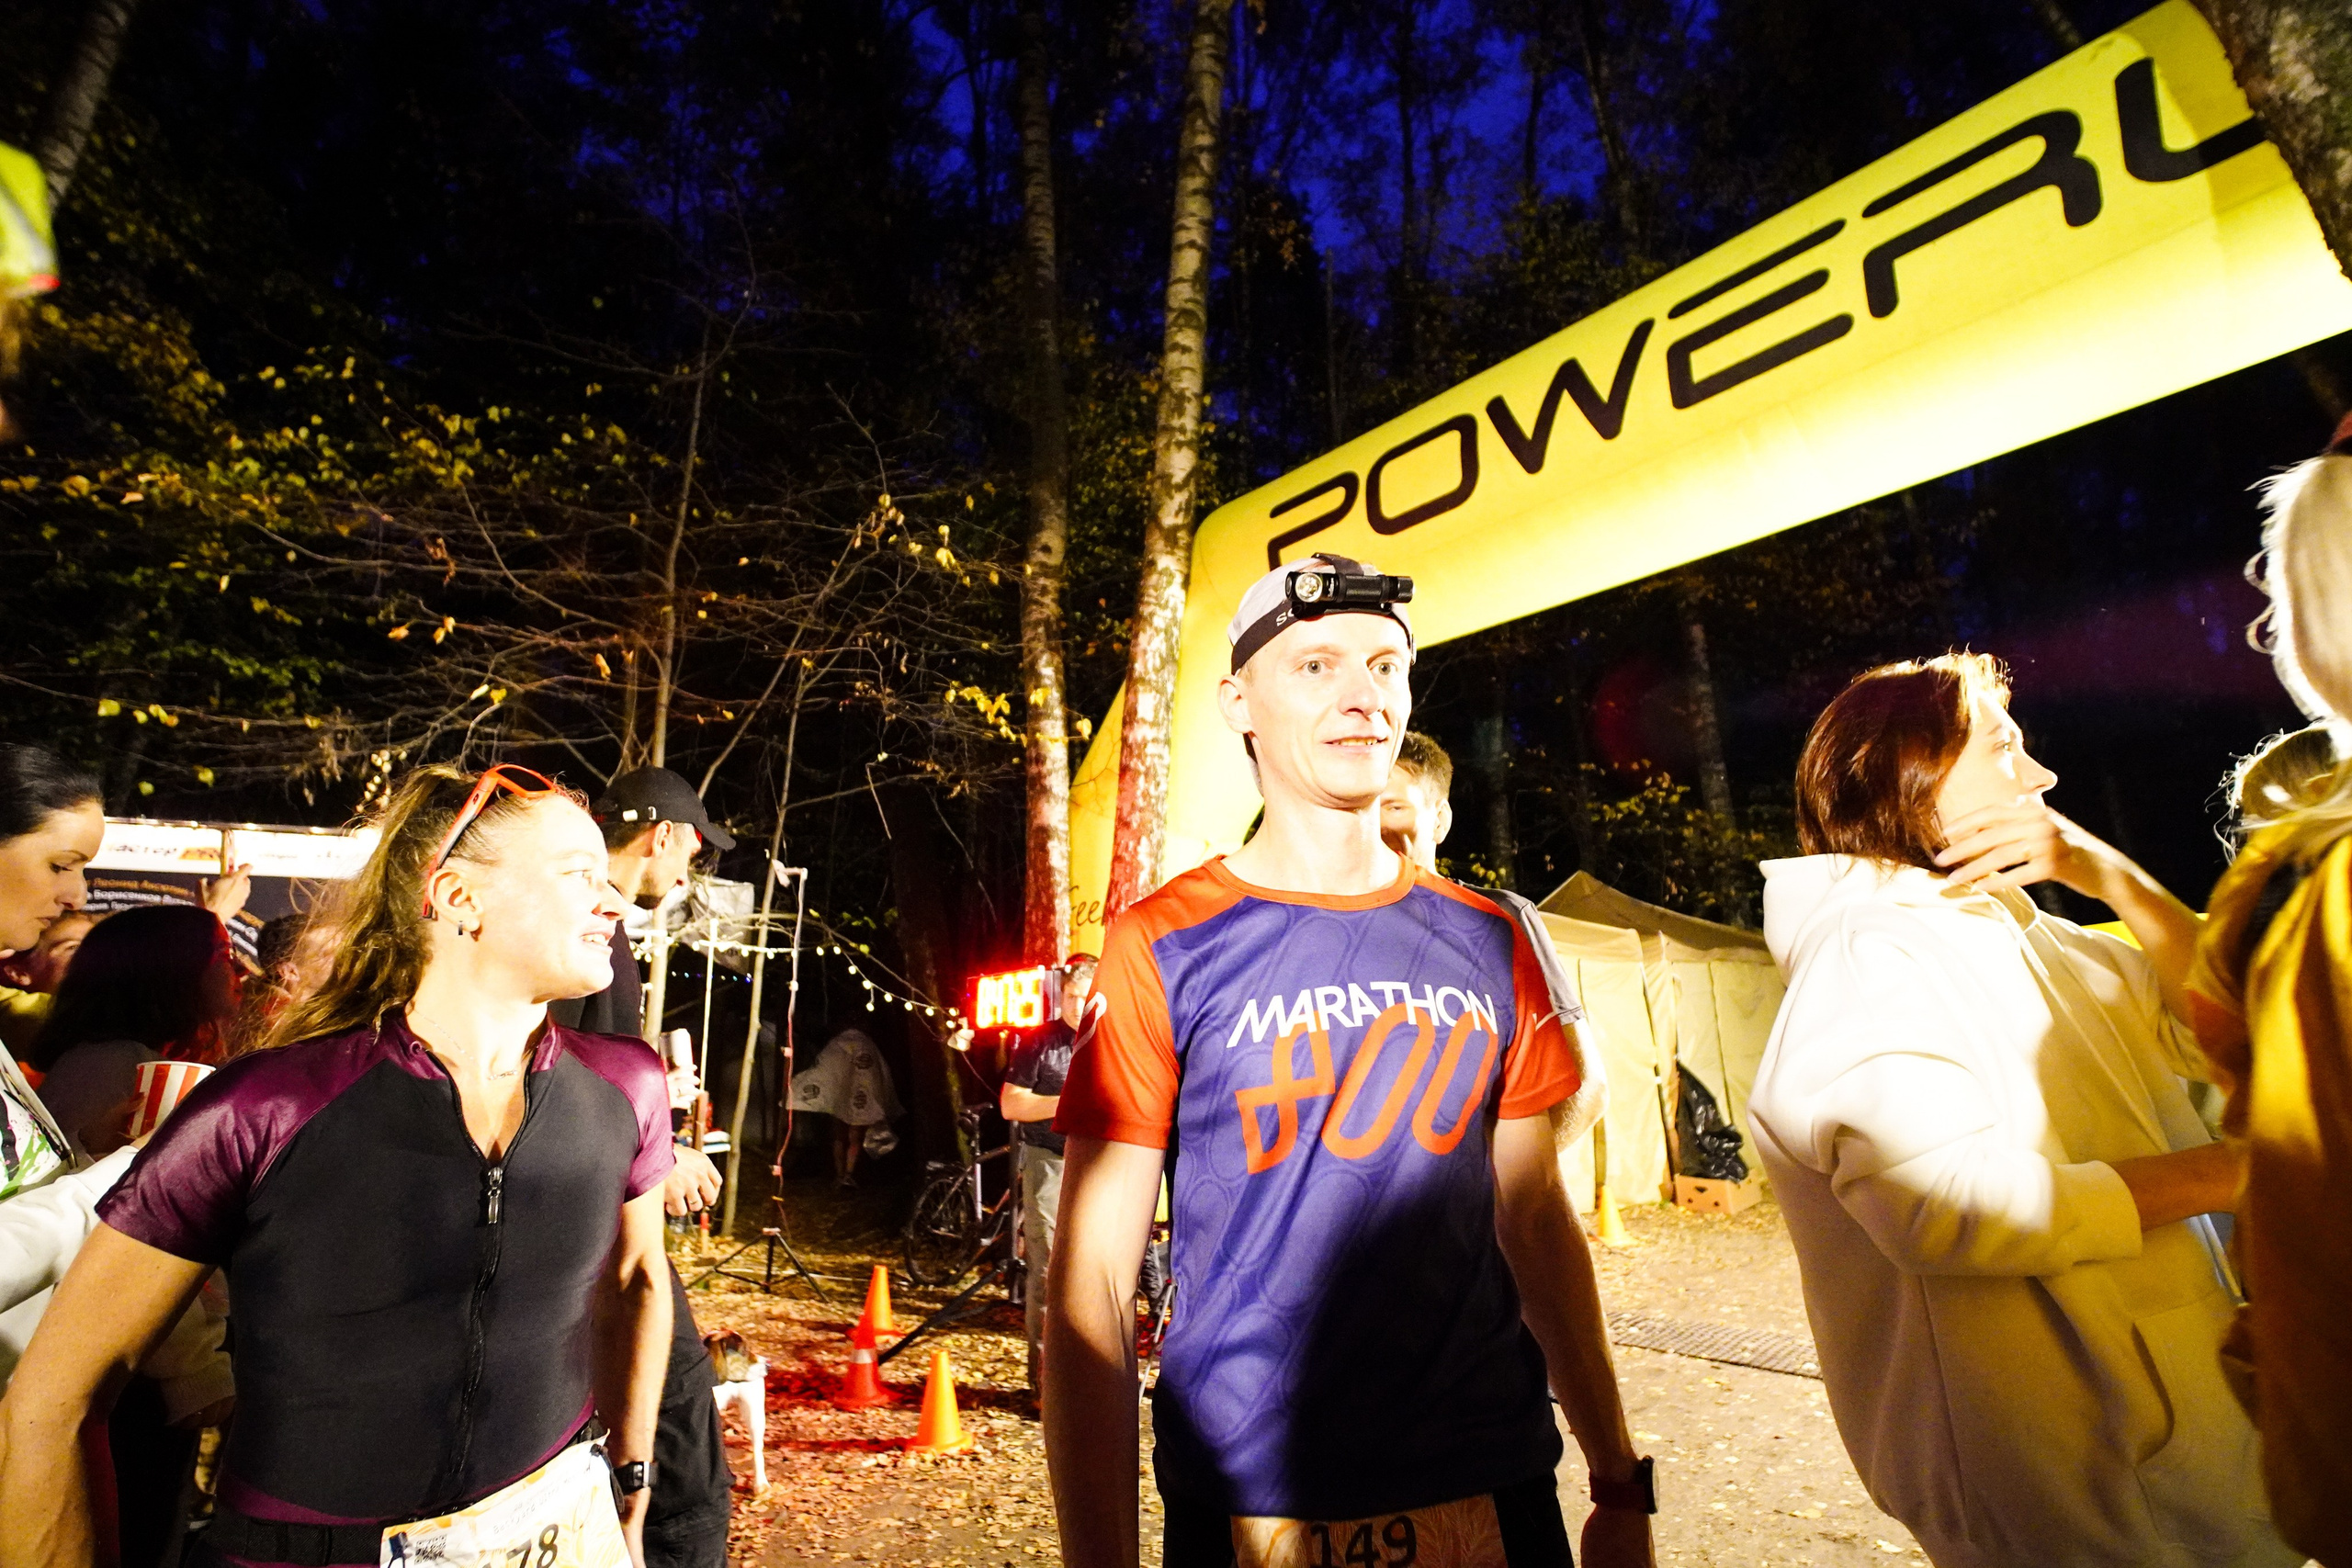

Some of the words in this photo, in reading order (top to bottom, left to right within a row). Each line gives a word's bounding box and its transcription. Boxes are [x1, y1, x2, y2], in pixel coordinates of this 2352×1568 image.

[1226, 980, 1498, 1049] MARATHON
[481, 1523, 560, 1568] 78
[1309, 1515, 1418, 1568] 149
